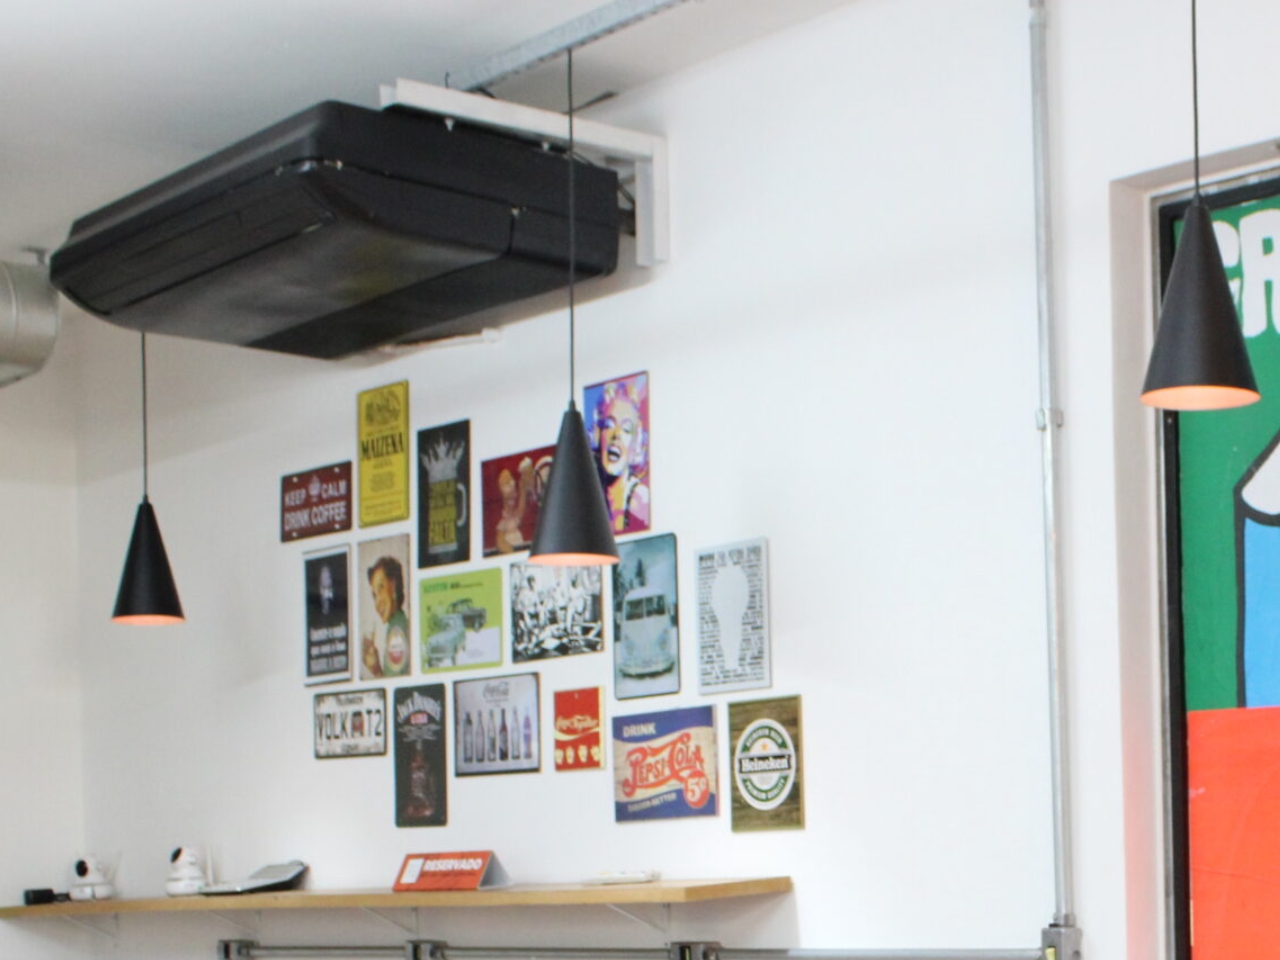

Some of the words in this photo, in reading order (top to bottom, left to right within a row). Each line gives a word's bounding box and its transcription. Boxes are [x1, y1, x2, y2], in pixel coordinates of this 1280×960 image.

[284, 487, 306, 507] KEEP
[321, 478, 348, 500] CALM
[284, 508, 311, 531] DRINK
[311, 501, 347, 526] COFFEE
[622, 722, 656, 738] DRINK
[741, 755, 790, 773] Heineken
[423, 858, 483, 871] RESERVADO
